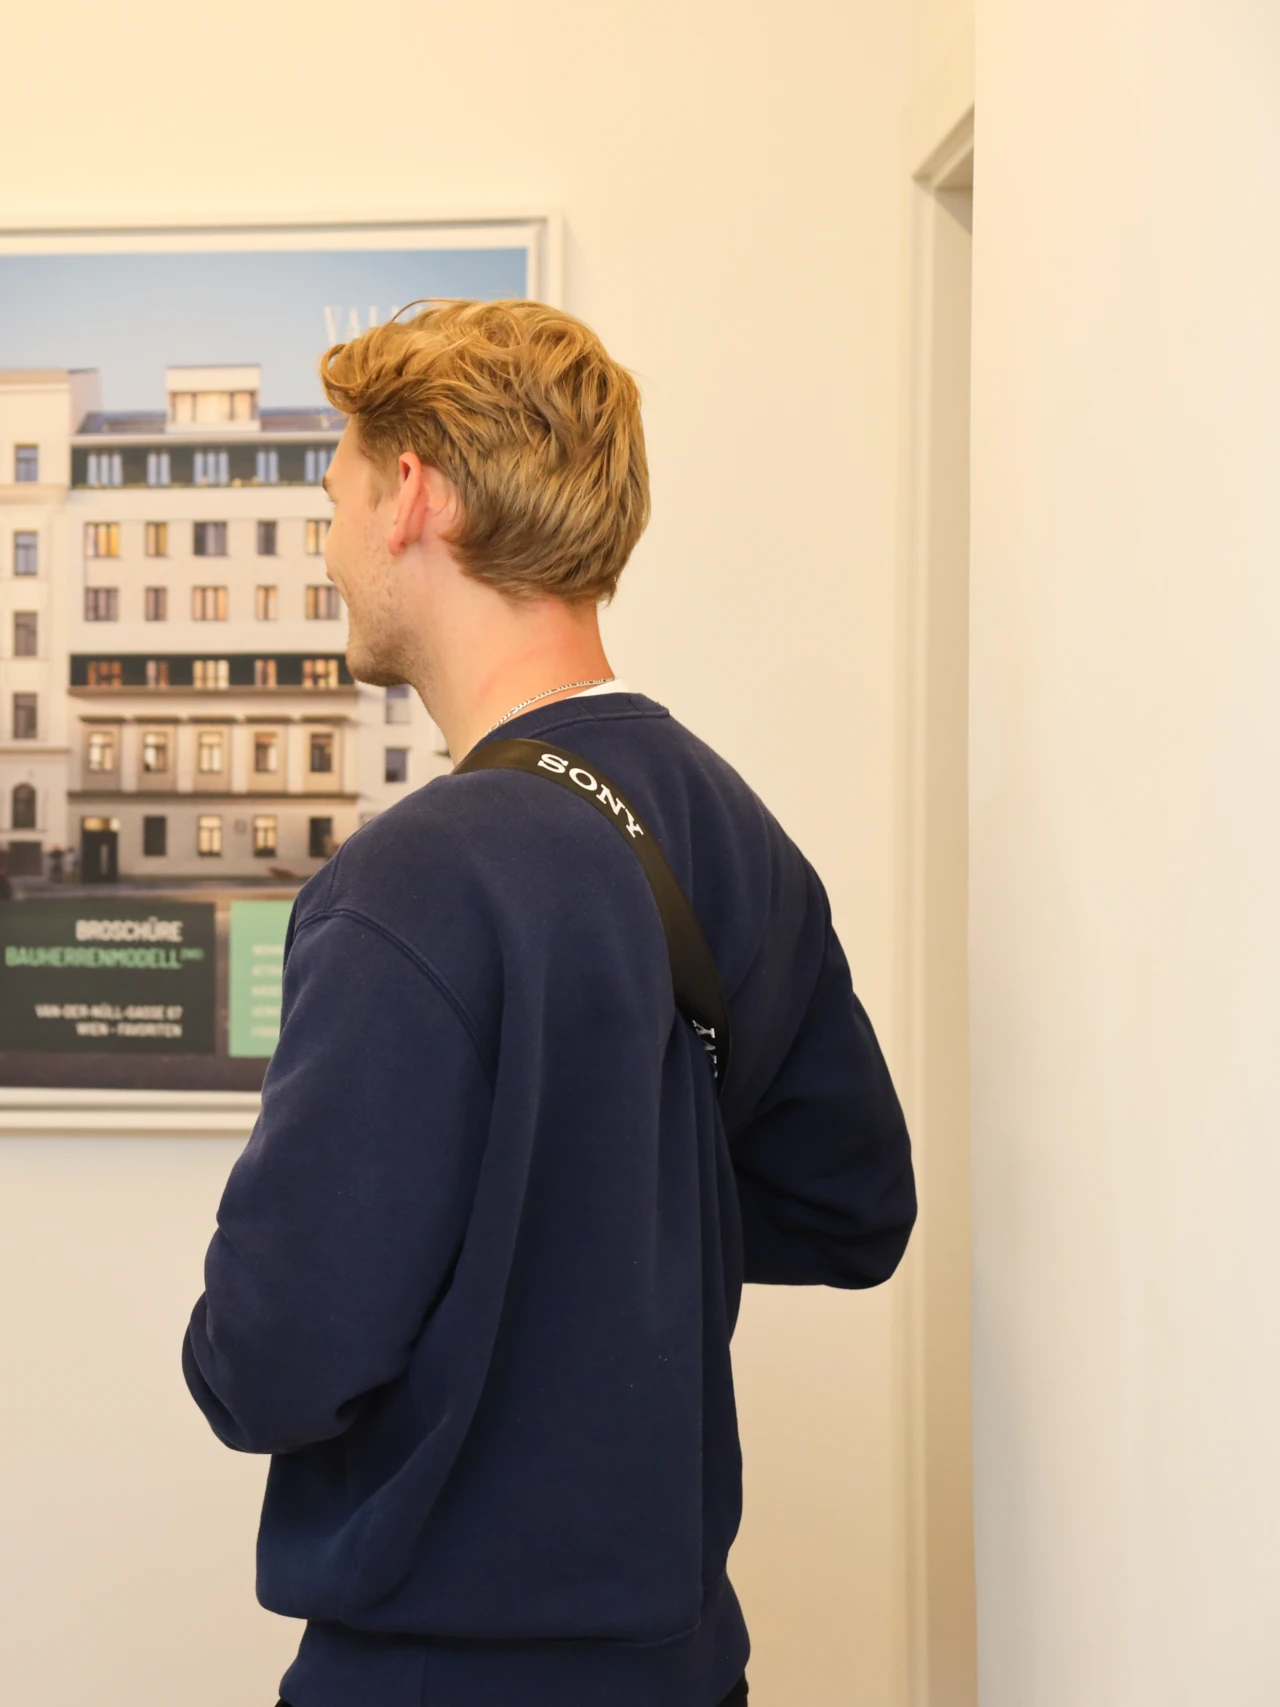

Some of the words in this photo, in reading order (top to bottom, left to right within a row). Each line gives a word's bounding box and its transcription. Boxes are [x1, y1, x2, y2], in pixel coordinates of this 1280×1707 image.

[537, 753, 644, 838] SONY
[76, 916, 183, 942] BROSCHÜRE
[76, 1022, 109, 1037] WIEN
[117, 1022, 183, 1038] FAVORITEN
